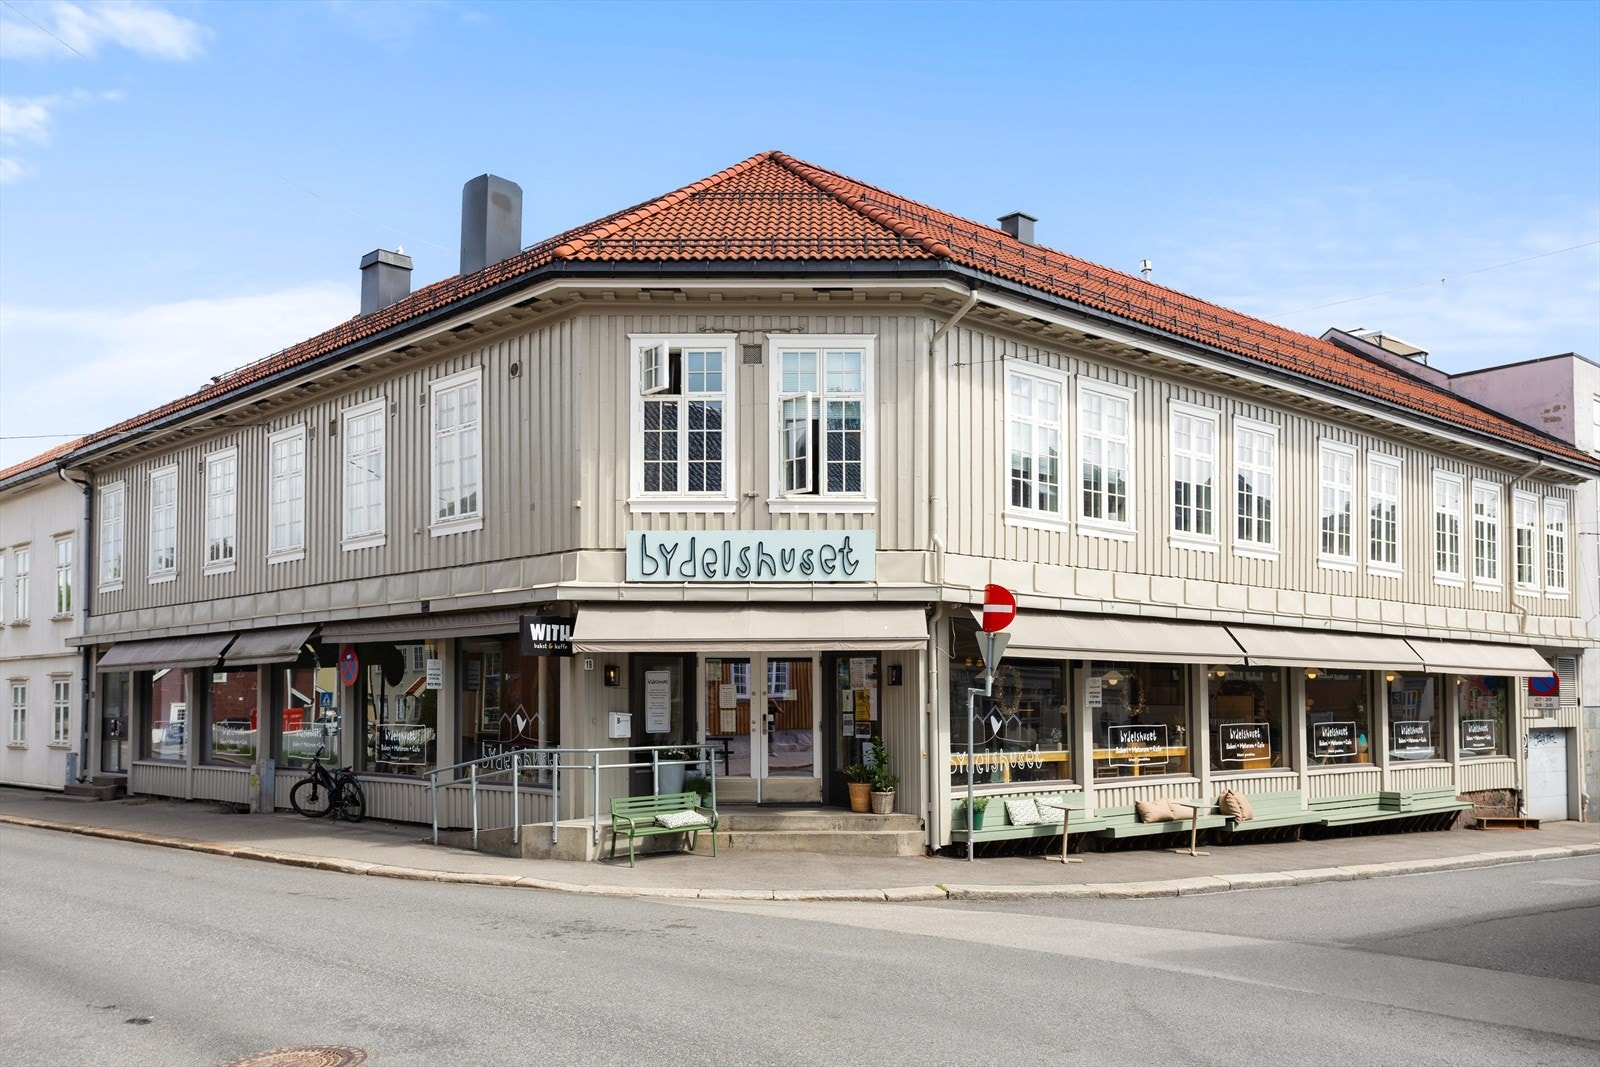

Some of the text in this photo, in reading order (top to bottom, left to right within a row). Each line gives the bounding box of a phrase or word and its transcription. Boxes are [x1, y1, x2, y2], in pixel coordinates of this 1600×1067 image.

[641, 533, 859, 578] bydelshuset
[530, 623, 570, 641] WITH
[585, 660, 593, 669] 19
[1120, 729, 1157, 743] bydelshuset
[1229, 727, 1261, 740] bydelshuset
